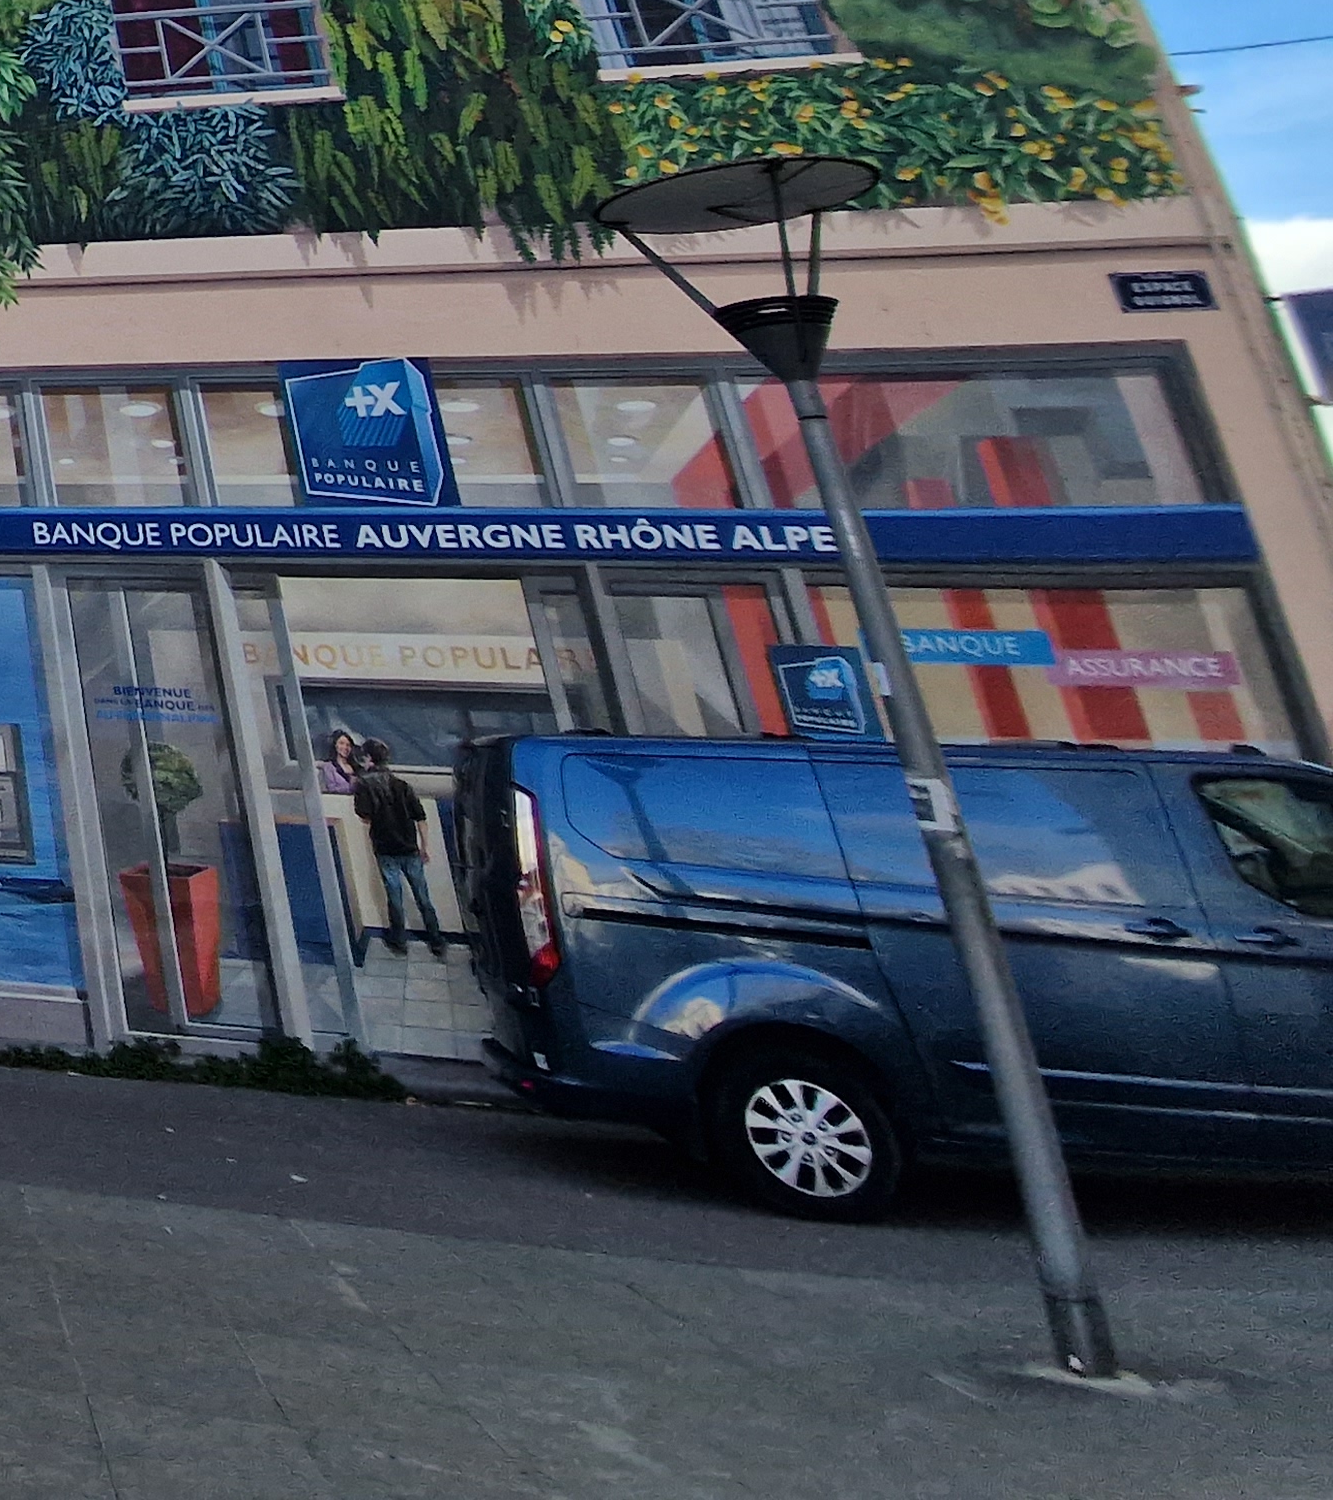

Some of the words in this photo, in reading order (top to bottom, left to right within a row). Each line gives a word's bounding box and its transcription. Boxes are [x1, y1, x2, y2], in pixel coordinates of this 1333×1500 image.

[311, 457, 421, 473] BANQUE
[315, 472, 425, 493] POPULAIRE
[33, 522, 162, 550] BANQUE
[171, 522, 342, 549] POPULAIRE
[355, 523, 566, 550] AUVERGNE
[575, 517, 722, 550] RHÔNE
[733, 524, 840, 552] ALPE
[1066, 655, 1225, 678] ASSURANCE
[113, 686, 192, 699] BIENVENUE
